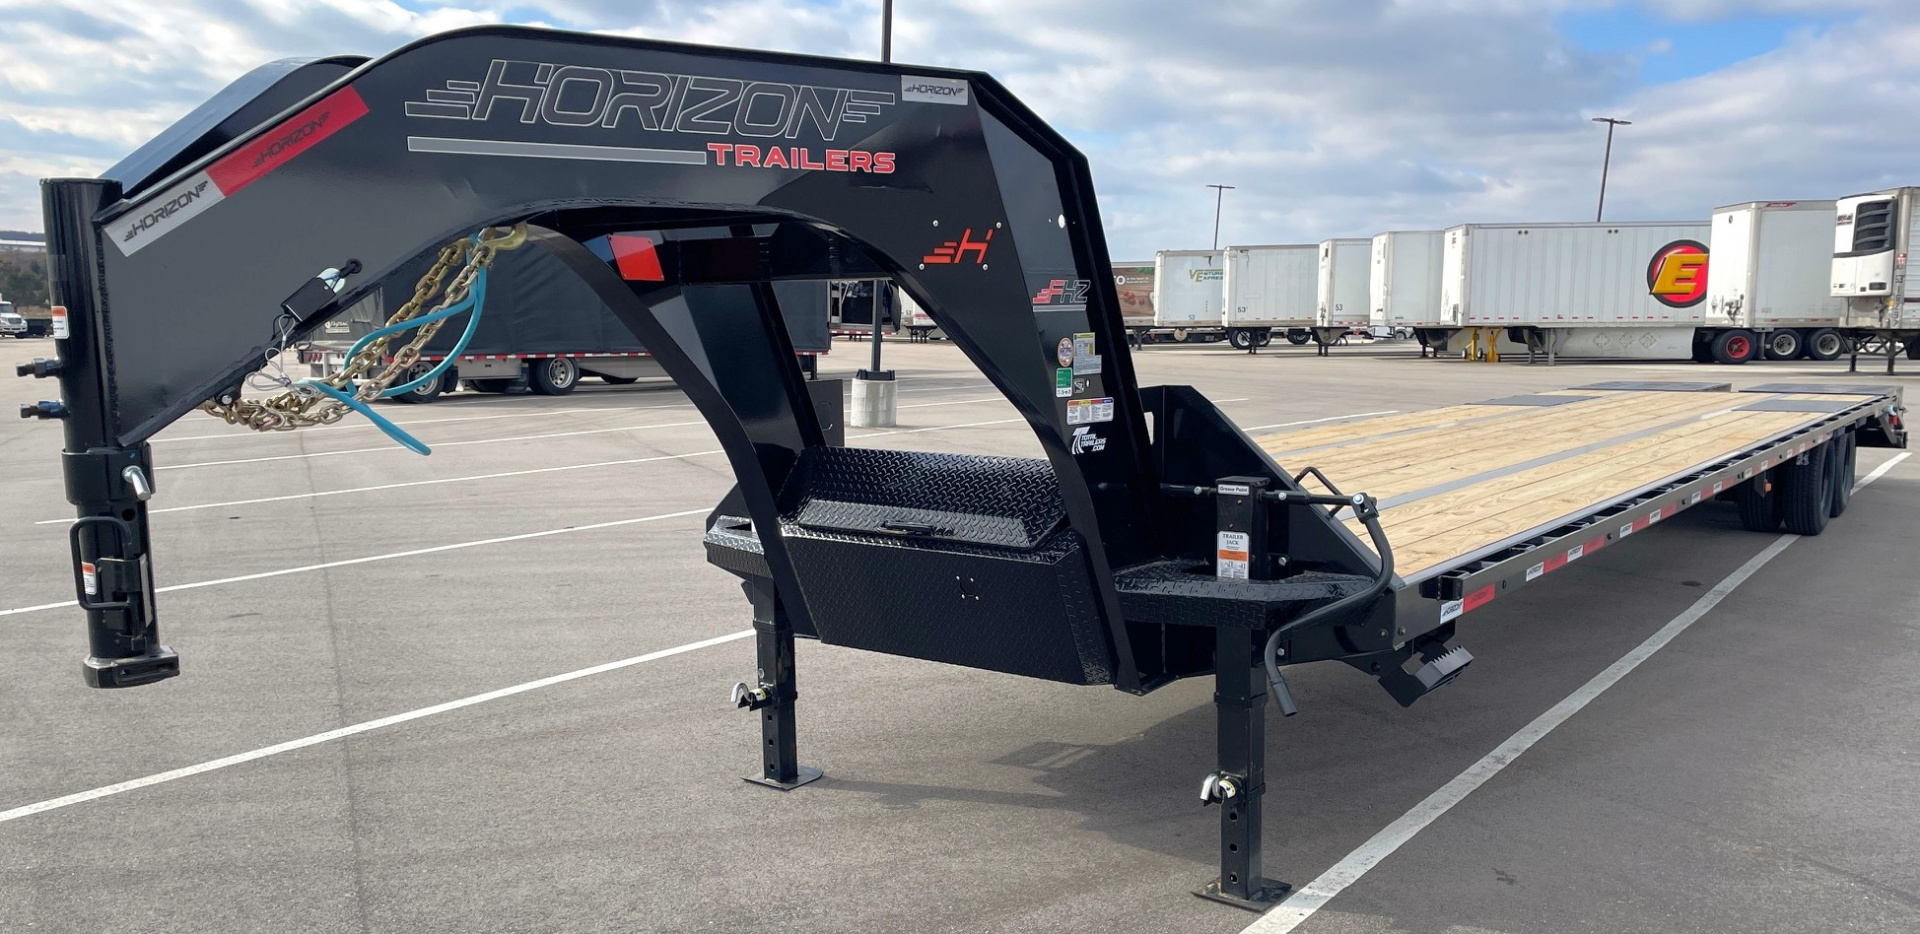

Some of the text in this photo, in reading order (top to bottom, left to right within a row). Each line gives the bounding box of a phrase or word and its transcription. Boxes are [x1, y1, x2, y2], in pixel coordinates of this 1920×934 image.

[471, 59, 851, 142] HORIZON
[910, 82, 959, 97] HORIZON
[256, 116, 326, 166] HORIZON
[706, 142, 896, 174] TRAILERS
[129, 184, 203, 239] HORIZON
